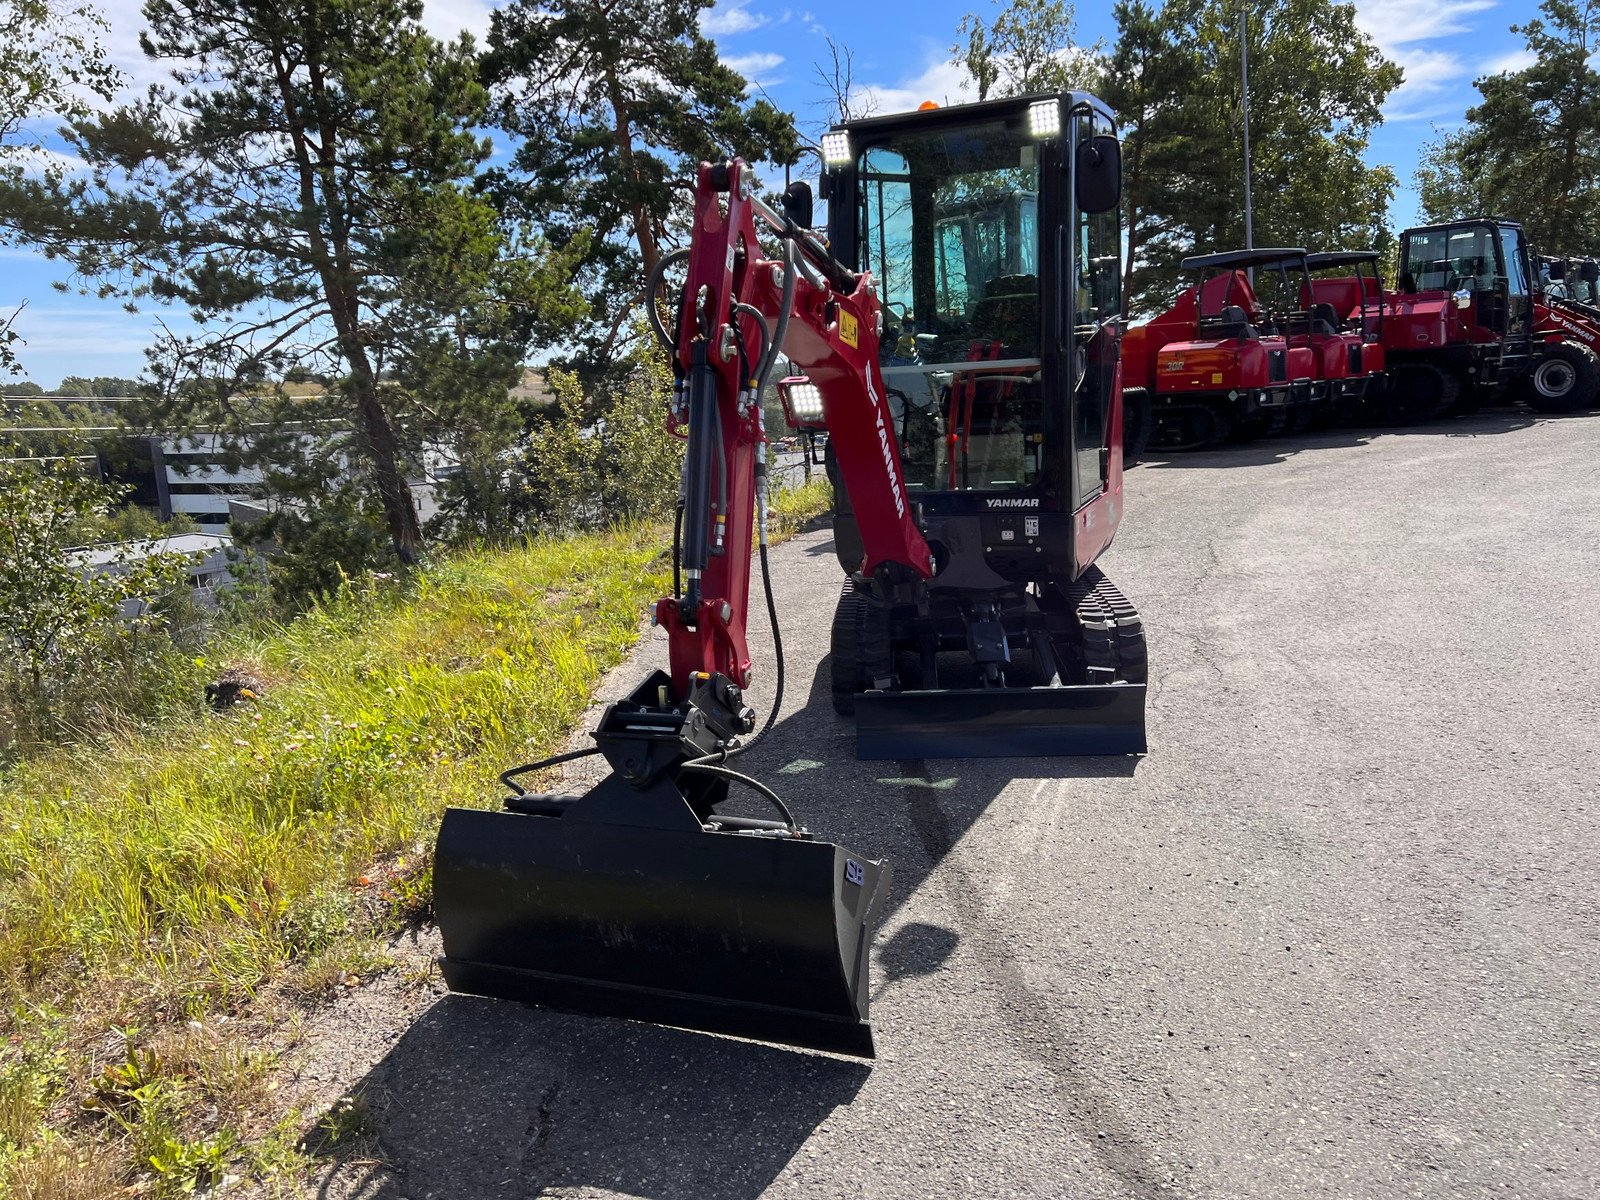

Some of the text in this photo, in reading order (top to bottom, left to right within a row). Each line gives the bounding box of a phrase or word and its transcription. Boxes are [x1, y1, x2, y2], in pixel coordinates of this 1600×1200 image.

[1562, 319, 1596, 342] YANMAR
[876, 407, 905, 519] YANMAR
[986, 498, 1040, 507] YANMAR
